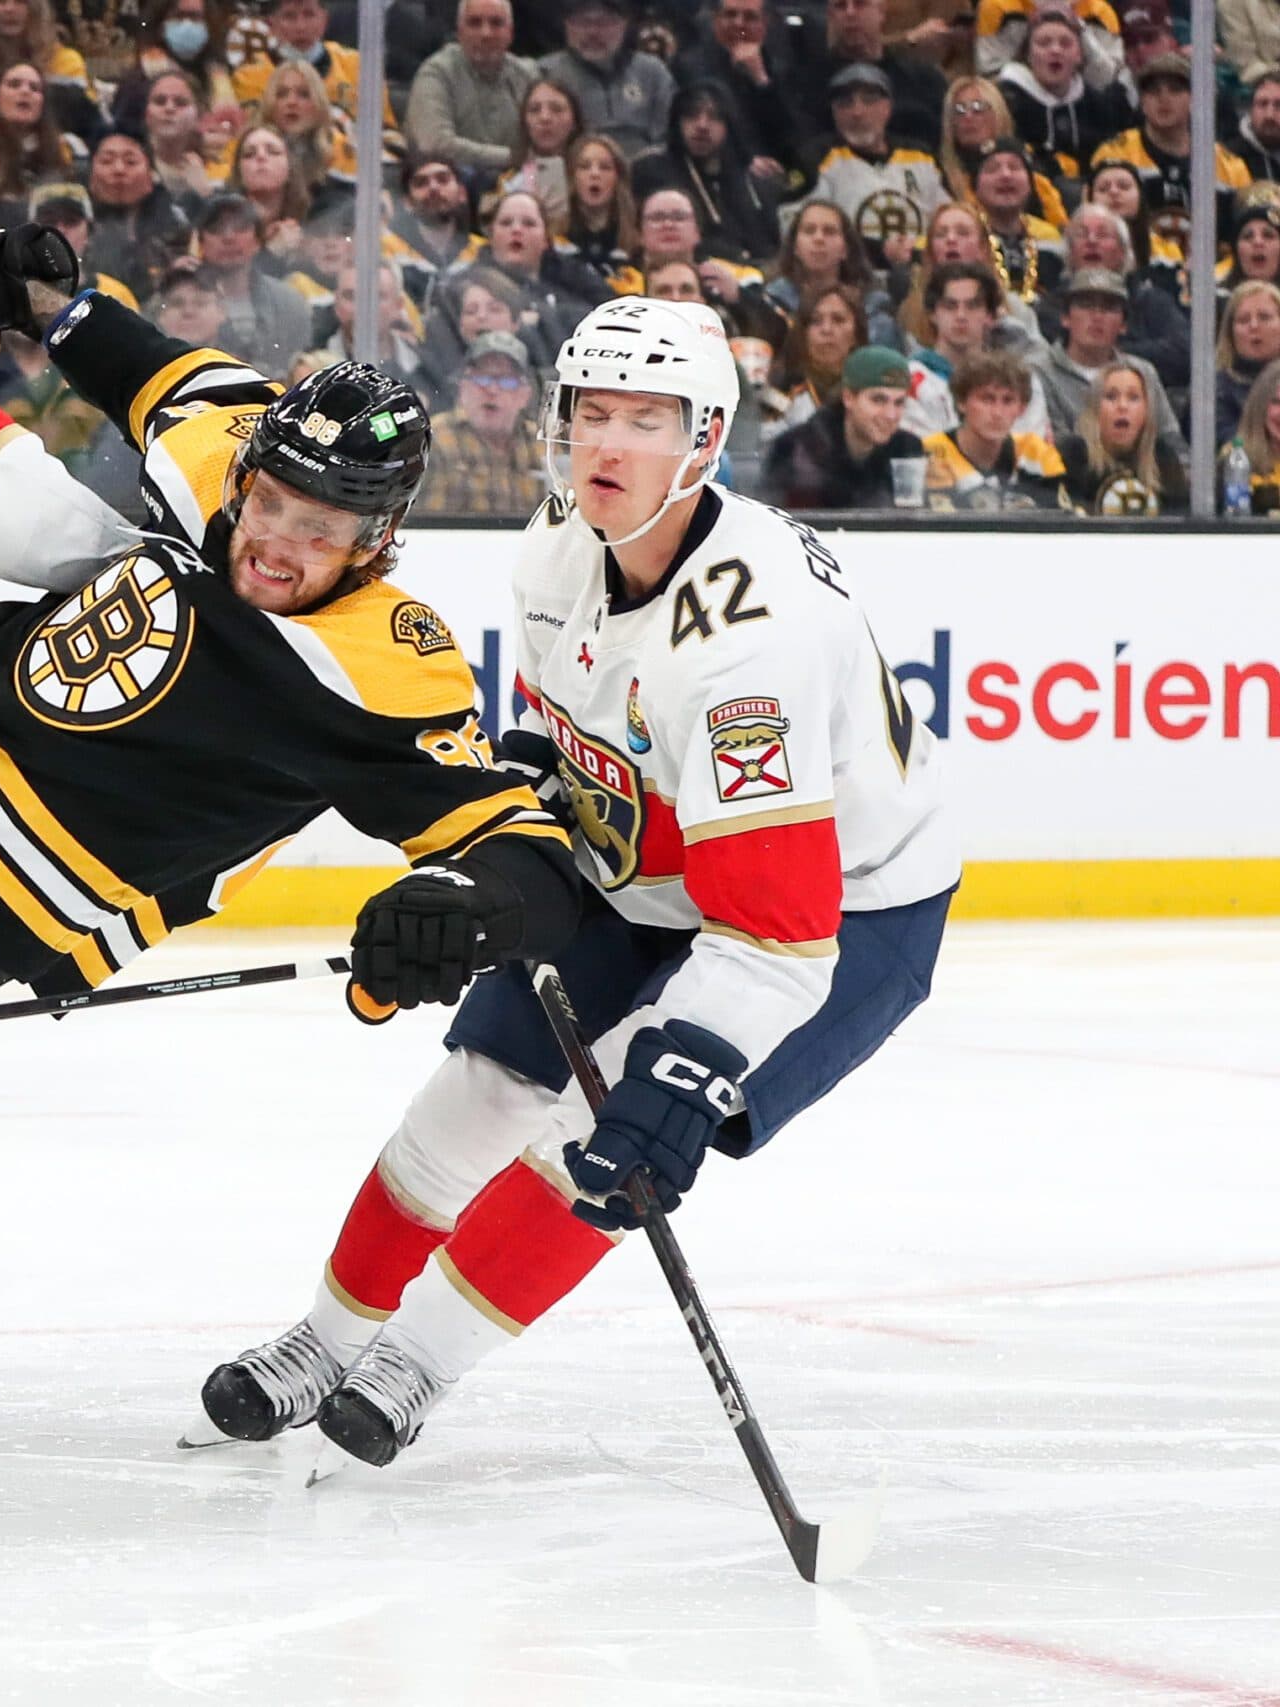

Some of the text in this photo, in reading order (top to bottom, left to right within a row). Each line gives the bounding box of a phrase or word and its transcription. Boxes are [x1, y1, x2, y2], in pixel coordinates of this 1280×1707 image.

[583, 347, 634, 361] CCM
[303, 411, 343, 447] 88
[276, 443, 326, 473] BAUER
[670, 557, 772, 650] 42
[716, 701, 772, 722] PANTHERS
[584, 1151, 618, 1172] CCM
